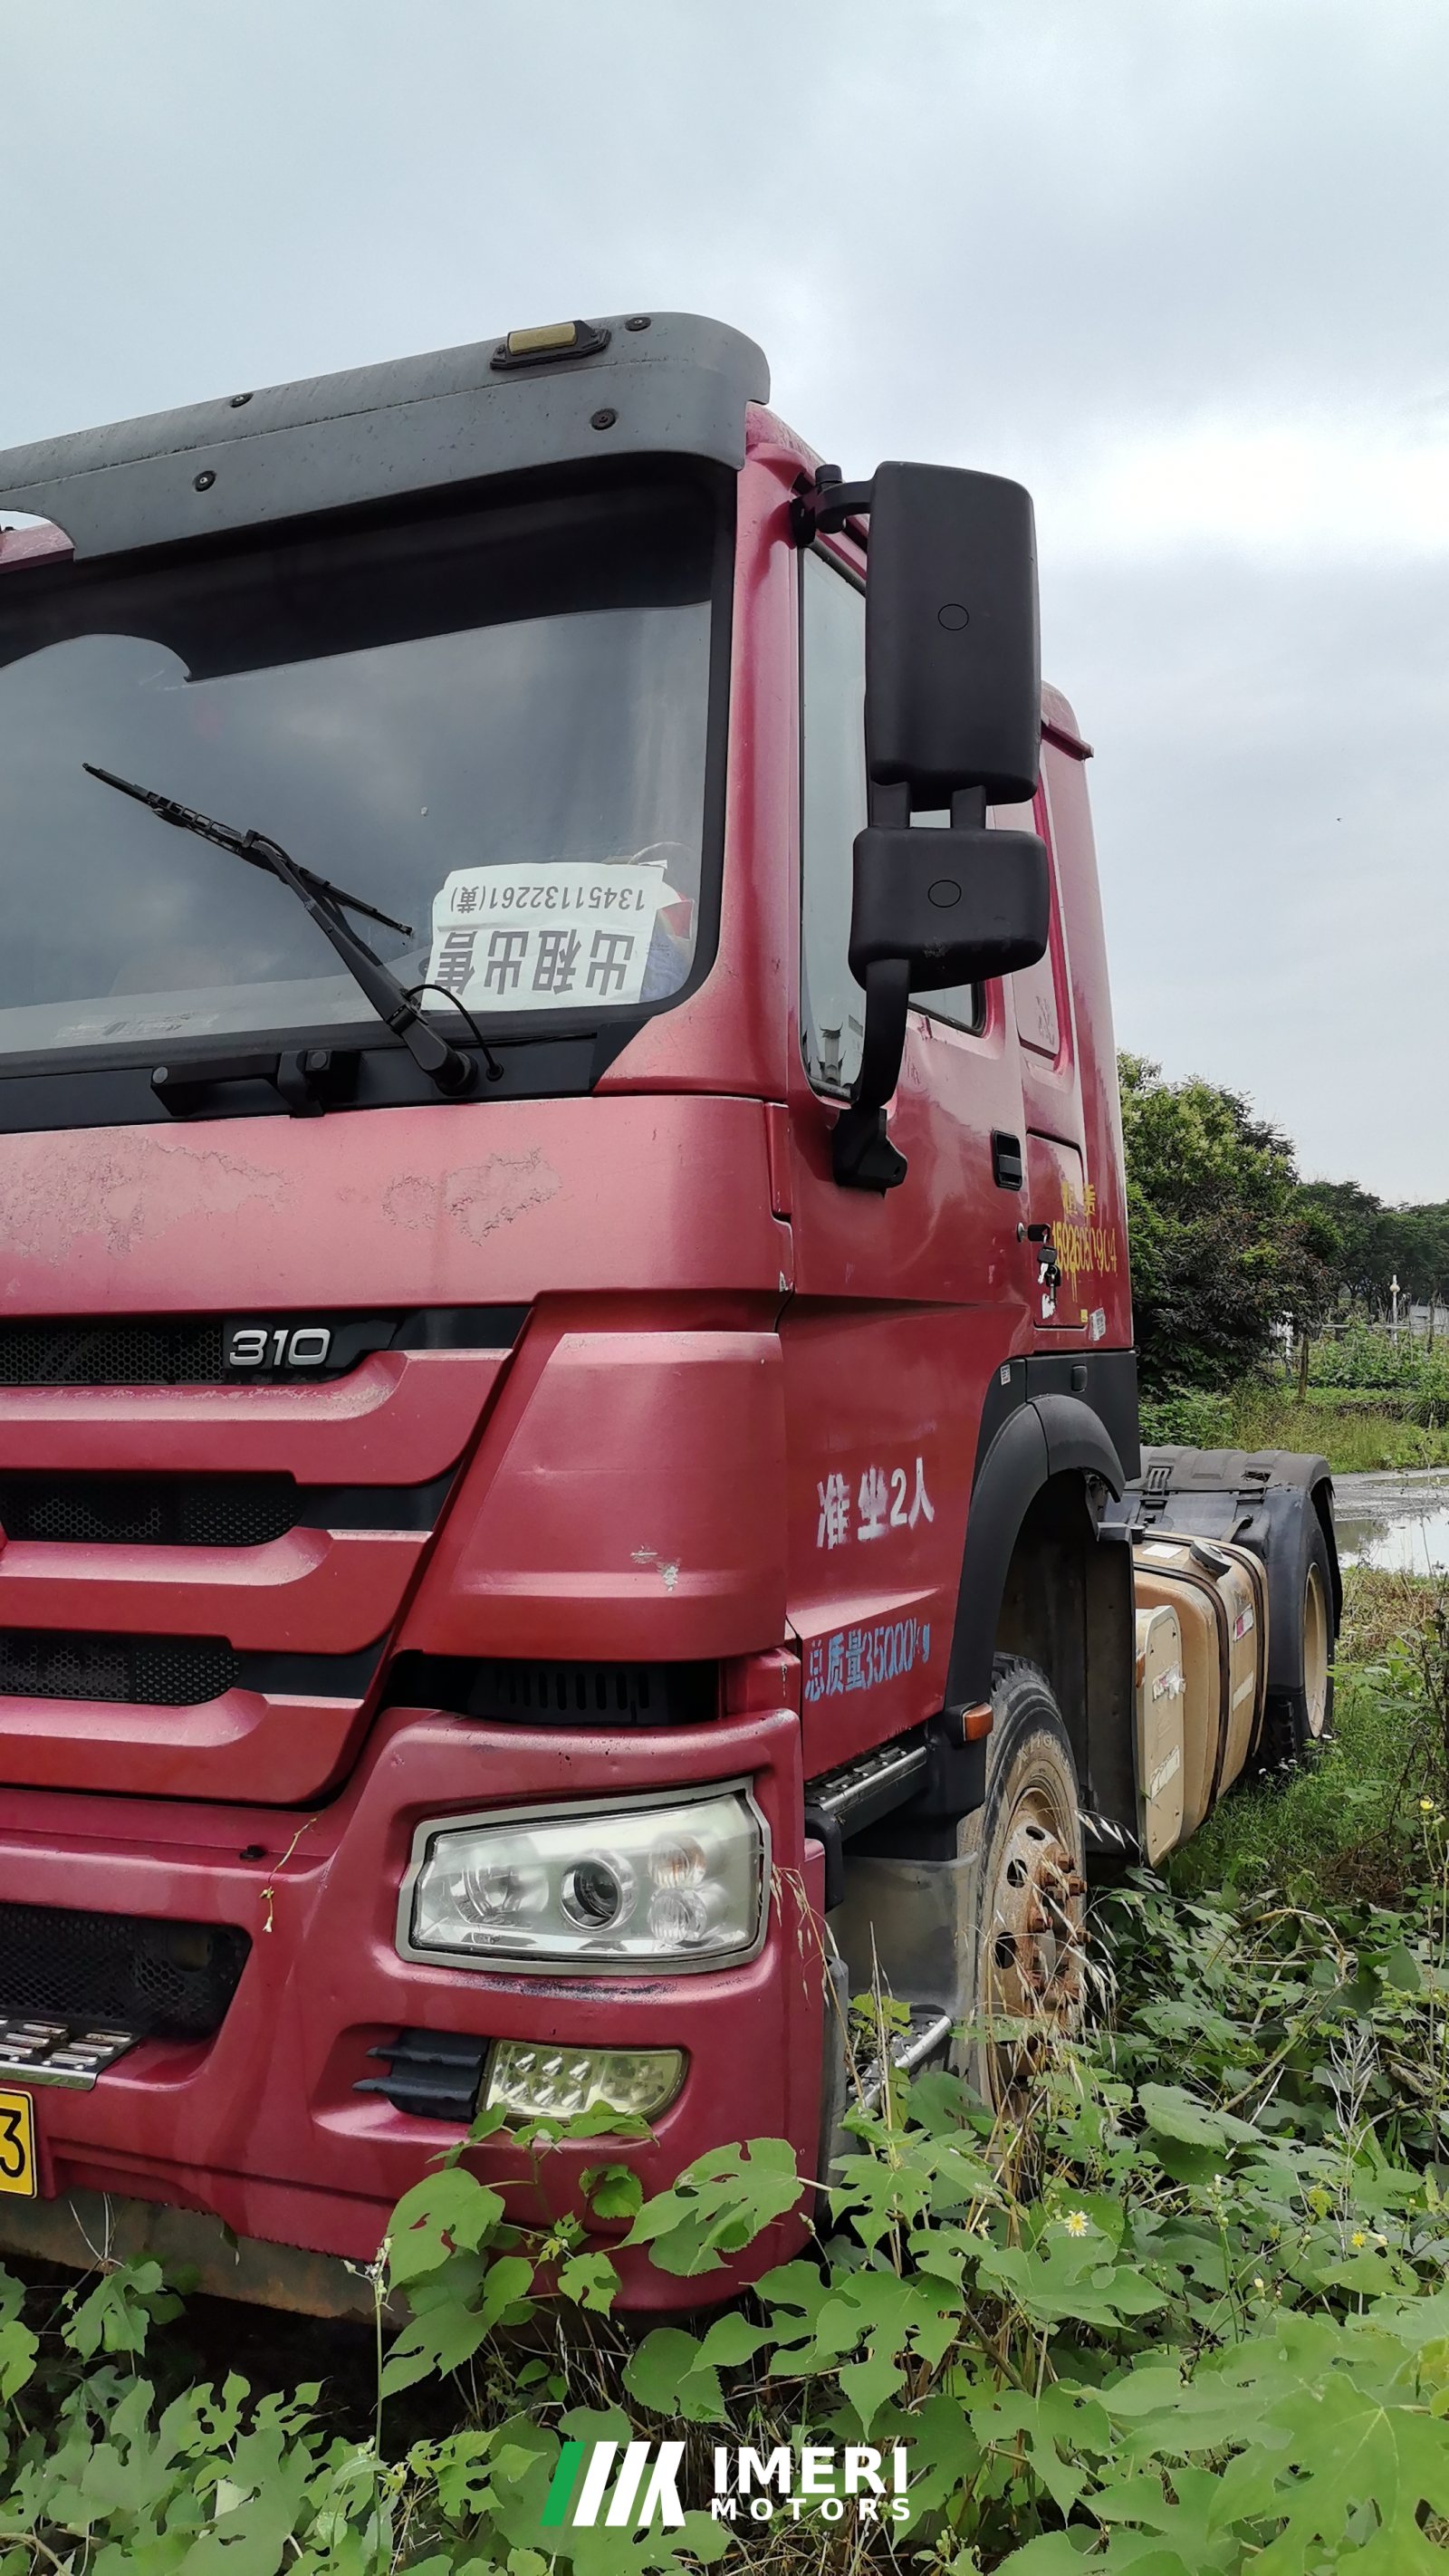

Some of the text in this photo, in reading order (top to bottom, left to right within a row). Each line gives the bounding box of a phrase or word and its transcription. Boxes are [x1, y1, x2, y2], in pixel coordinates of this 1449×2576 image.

[451, 886, 645, 914] 13451132261(黄)
[434, 929, 635, 996] 出租出售
[229, 1328, 331, 1366] 310
